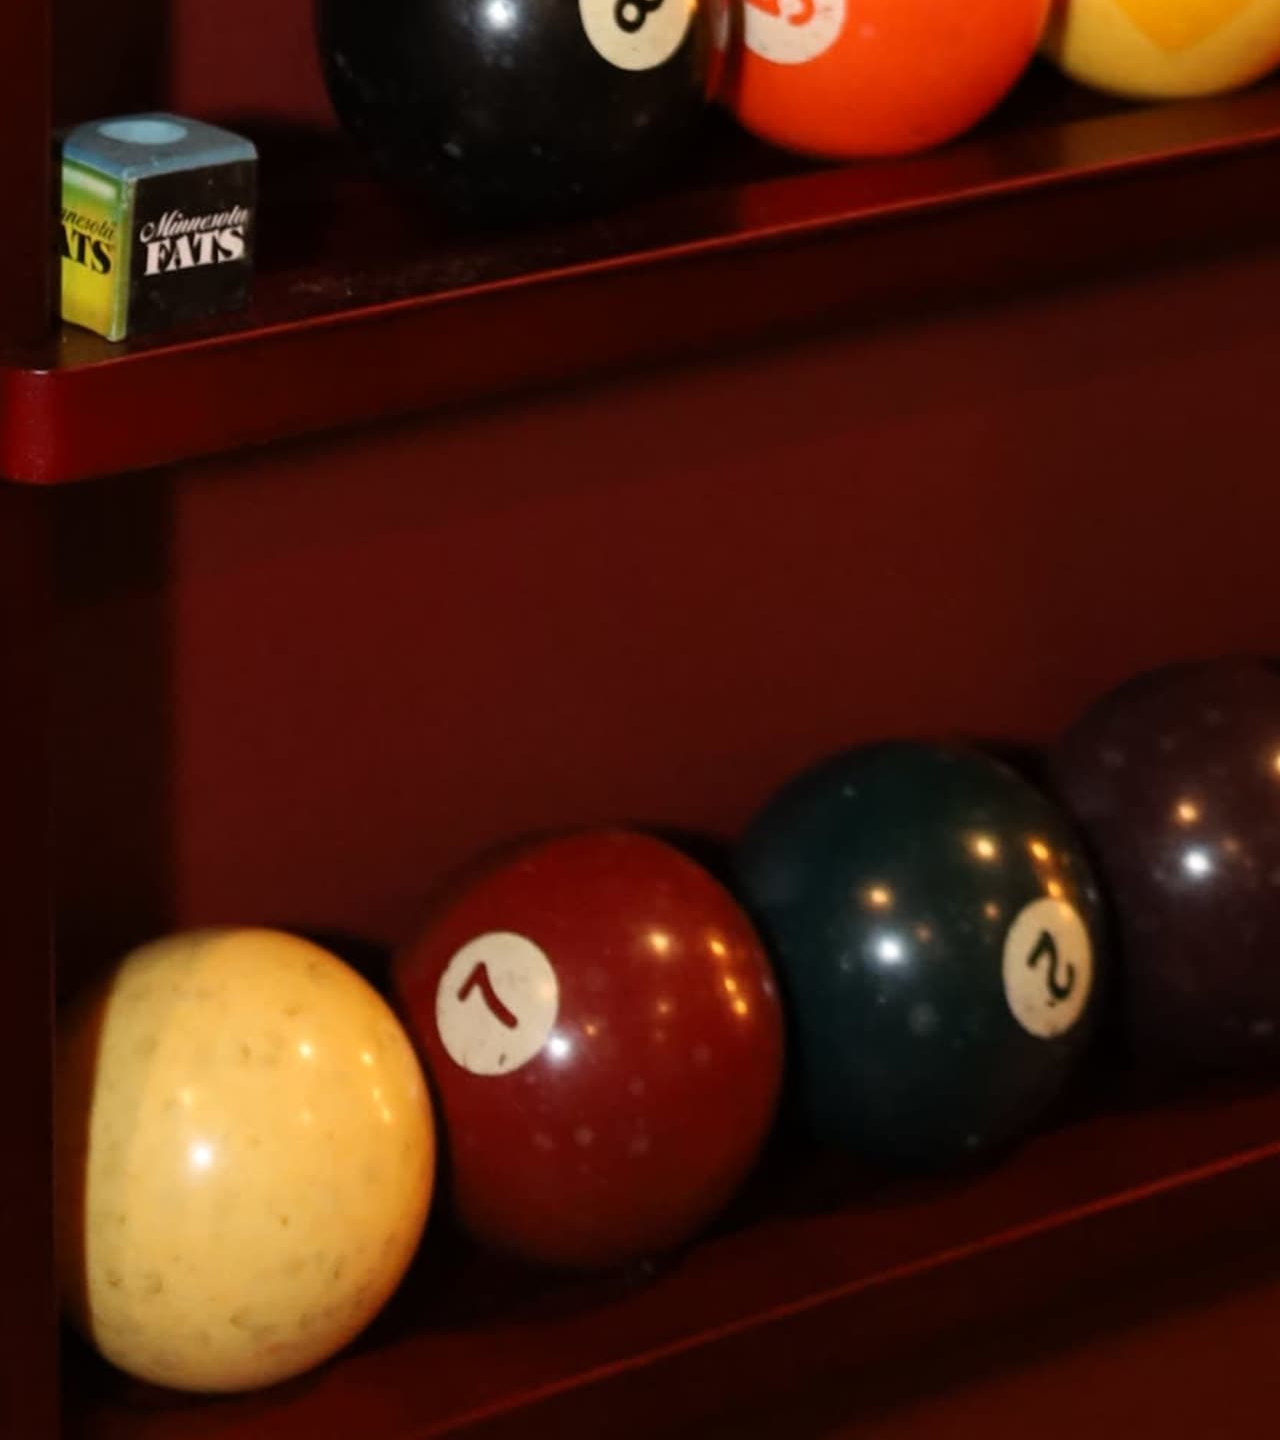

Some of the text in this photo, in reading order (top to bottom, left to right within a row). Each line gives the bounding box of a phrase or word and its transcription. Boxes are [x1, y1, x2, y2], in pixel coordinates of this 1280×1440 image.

[140, 204, 248, 244] Minnesota
[144, 225, 245, 276] FATS
[457, 960, 519, 1029] 7
[1026, 930, 1075, 1001] 2
